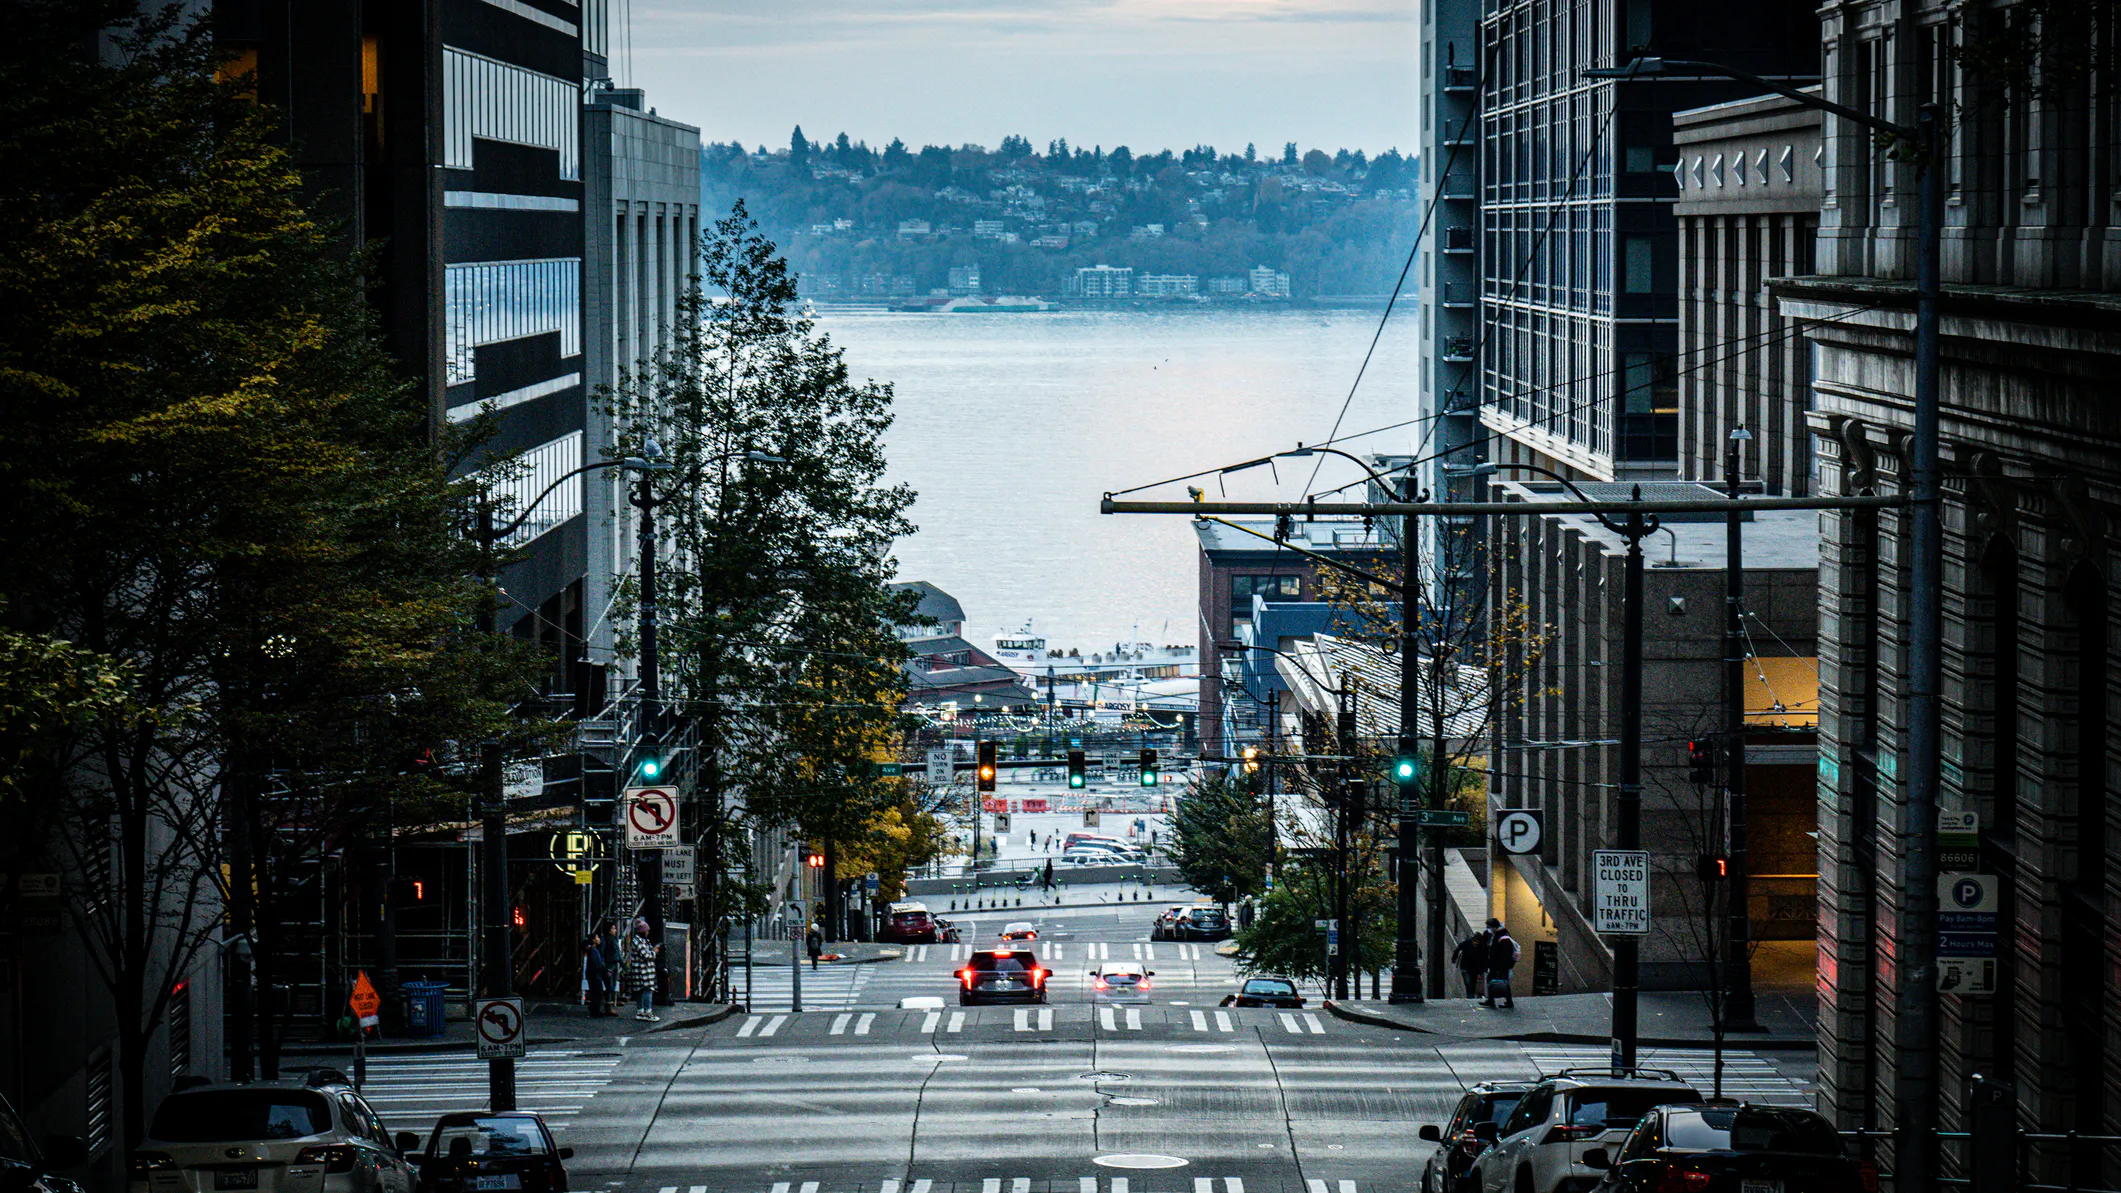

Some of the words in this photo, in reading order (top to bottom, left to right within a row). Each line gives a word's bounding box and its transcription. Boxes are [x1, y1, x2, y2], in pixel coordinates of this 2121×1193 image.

[1104, 702, 1131, 710] ARGOSY
[933, 753, 947, 761] NO
[1452, 815, 1466, 823] Ave
[1510, 819, 1529, 846] P
[676, 849, 692, 857] LANE
[1940, 853, 1975, 863] 86606
[664, 860, 685, 869] MUST
[1600, 855, 1620, 867] 3RD
[1624, 855, 1643, 867] AVE
[676, 872, 692, 880] LEFT
[1600, 869, 1643, 881] CLOSED
[1617, 884, 1628, 893] TO
[1961, 884, 1976, 902] P
[1606, 896, 1638, 907] THRU
[1599, 908, 1646, 921] TRAFFIC
[1939, 914, 1954, 924] Pay
[1956, 914, 1995, 924] 8am-8pm
[1939, 936, 1948, 948] 2
[1949, 940, 1975, 948] Hours
[1976, 940, 1995, 948] Max
